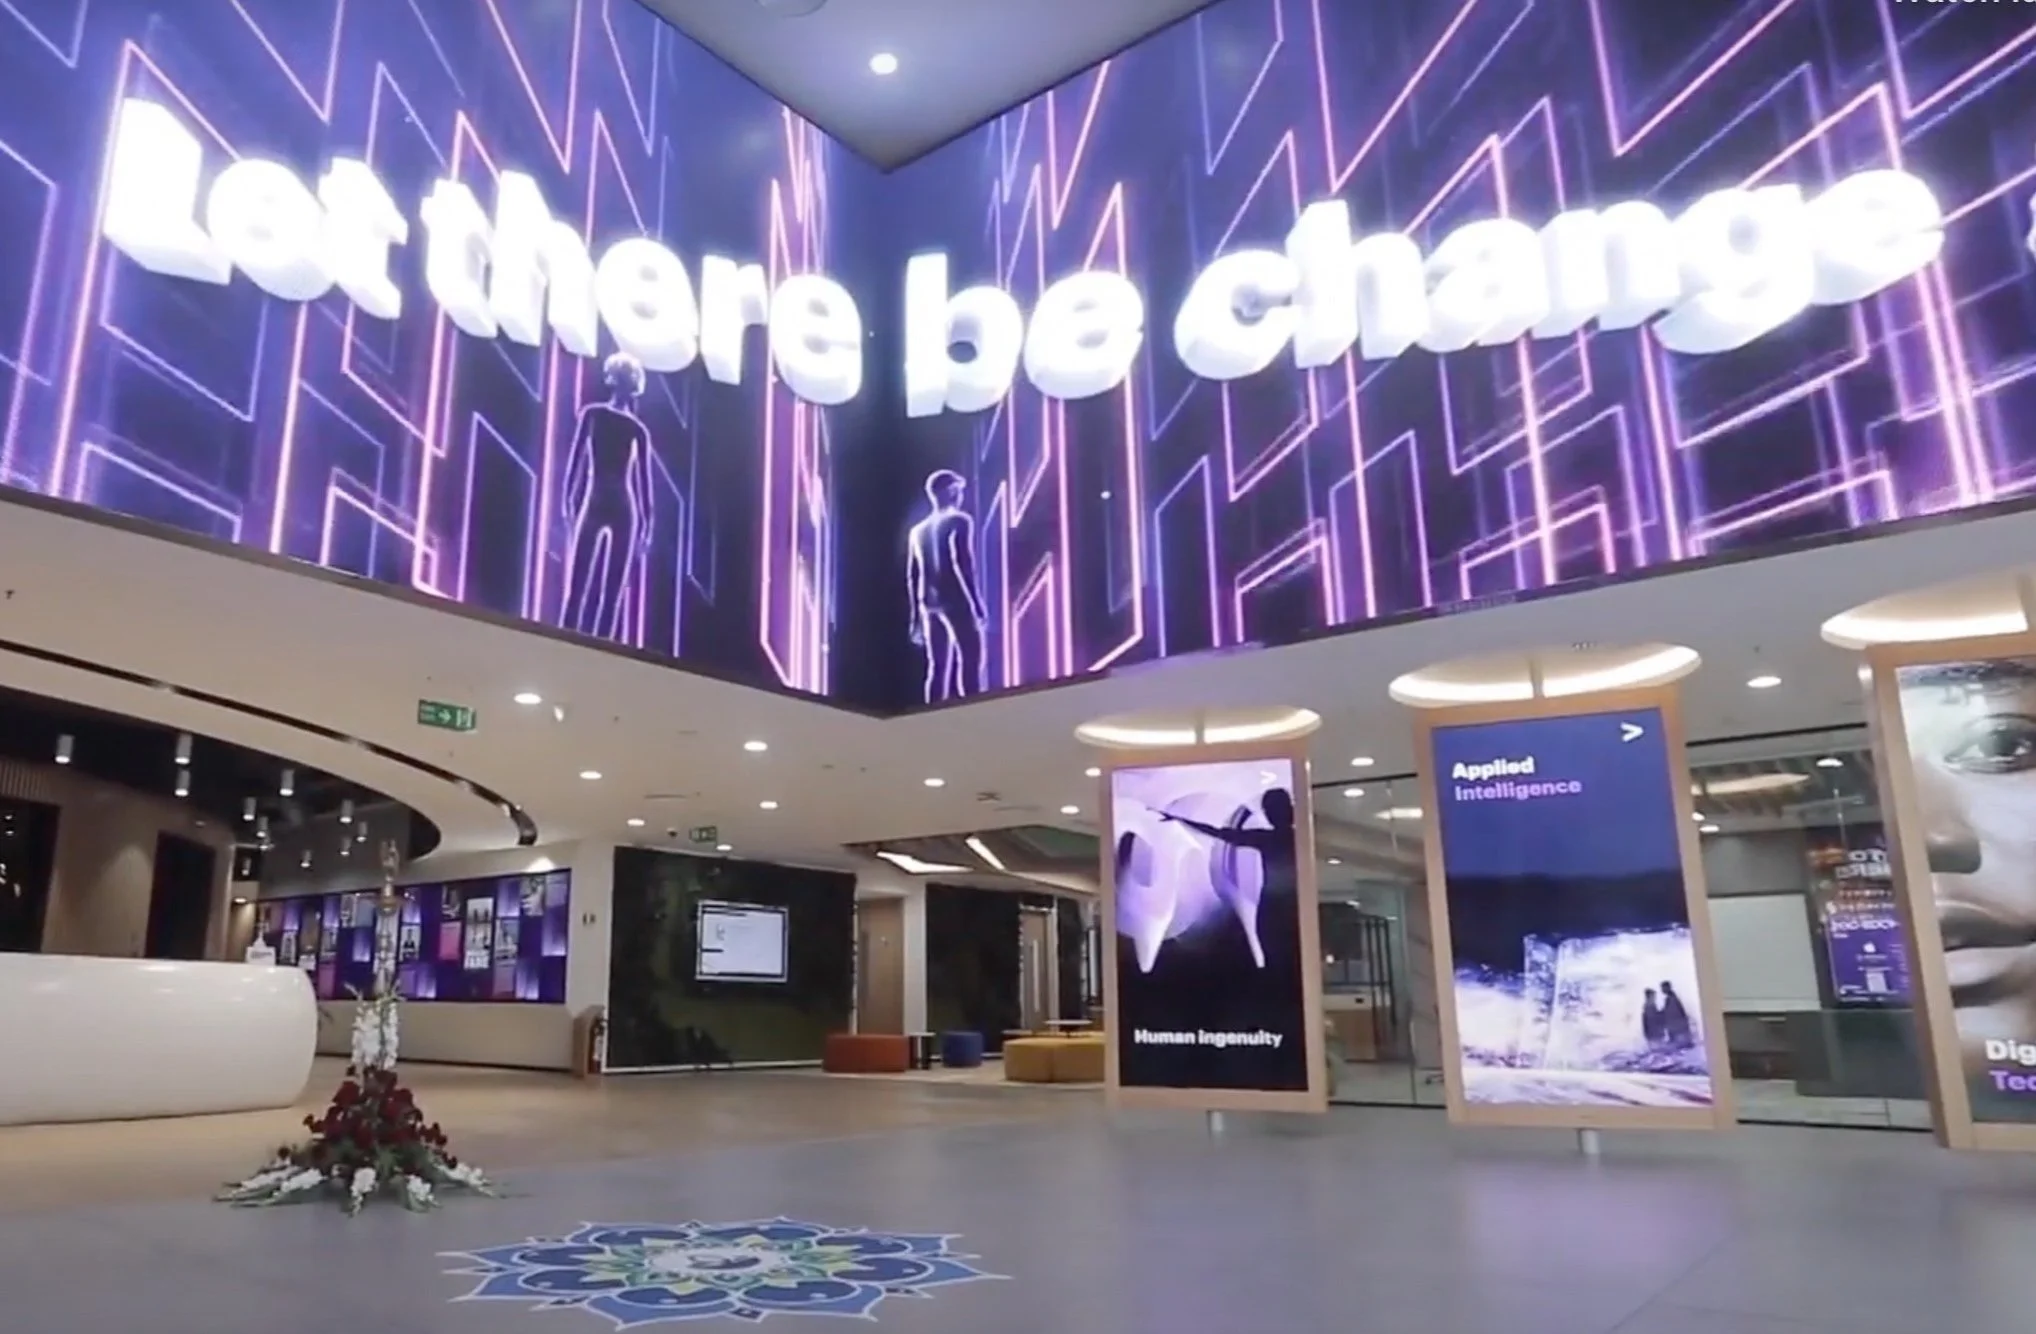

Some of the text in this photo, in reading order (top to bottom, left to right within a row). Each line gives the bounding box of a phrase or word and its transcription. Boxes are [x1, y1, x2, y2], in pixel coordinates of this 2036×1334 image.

[103, 97, 1944, 418] Let there be change
[1452, 756, 1535, 780] Applied
[1455, 780, 1582, 801] Intelligence
[1134, 1028, 1196, 1044] Human
[1985, 1039, 2036, 1066] Dig
